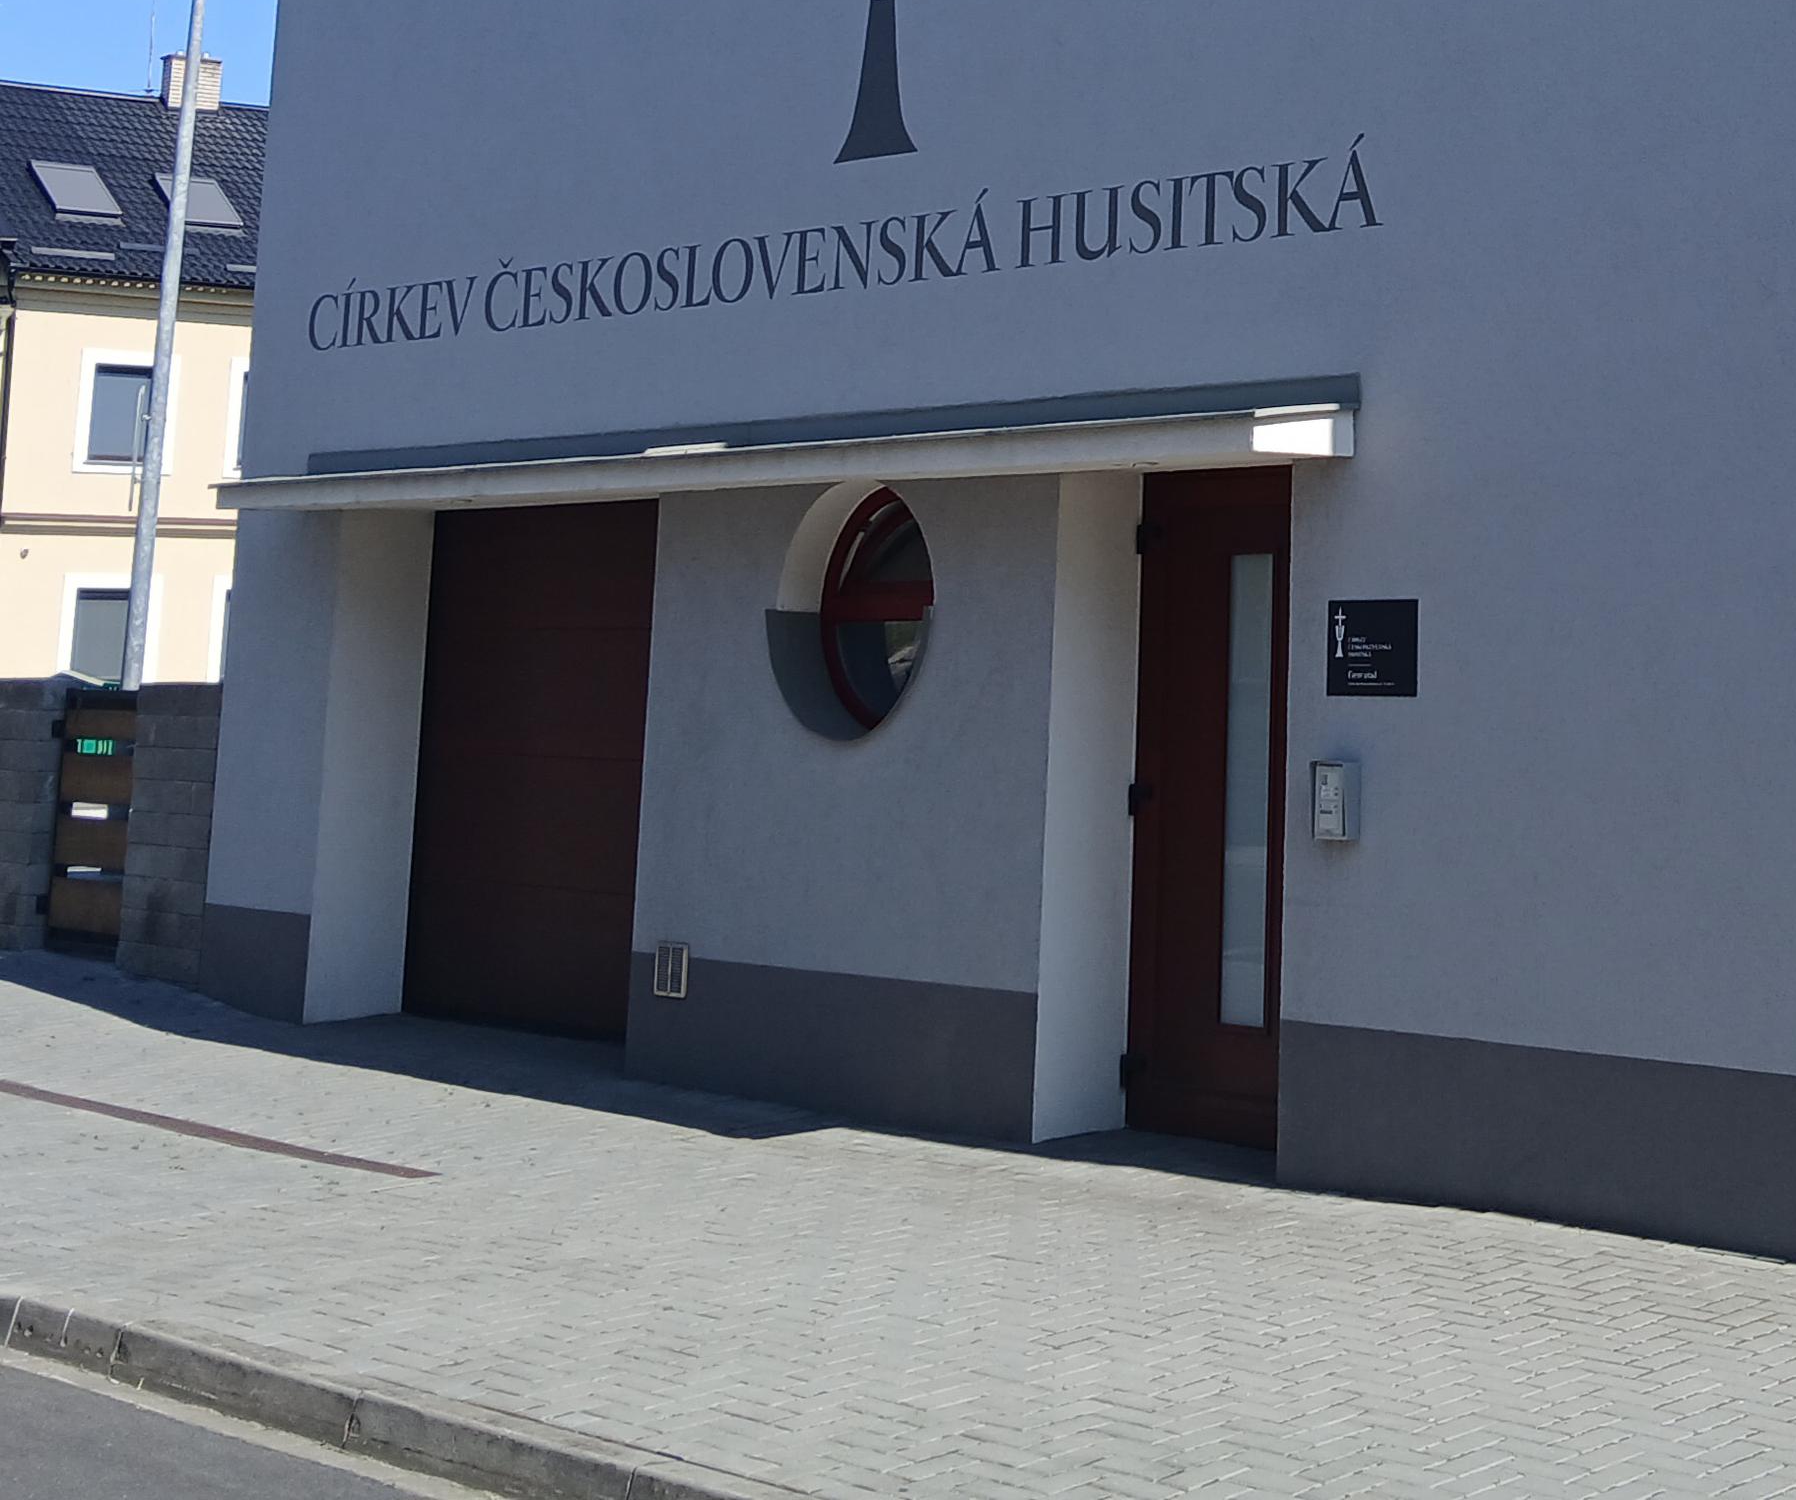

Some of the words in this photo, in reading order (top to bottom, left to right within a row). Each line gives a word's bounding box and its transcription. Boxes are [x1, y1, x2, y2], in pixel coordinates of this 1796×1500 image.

[308, 277, 478, 351] CÍRKEV
[484, 187, 1001, 332] ČESKOSLOVENSKÁ
[1014, 132, 1385, 269] HUSITSKÁ
